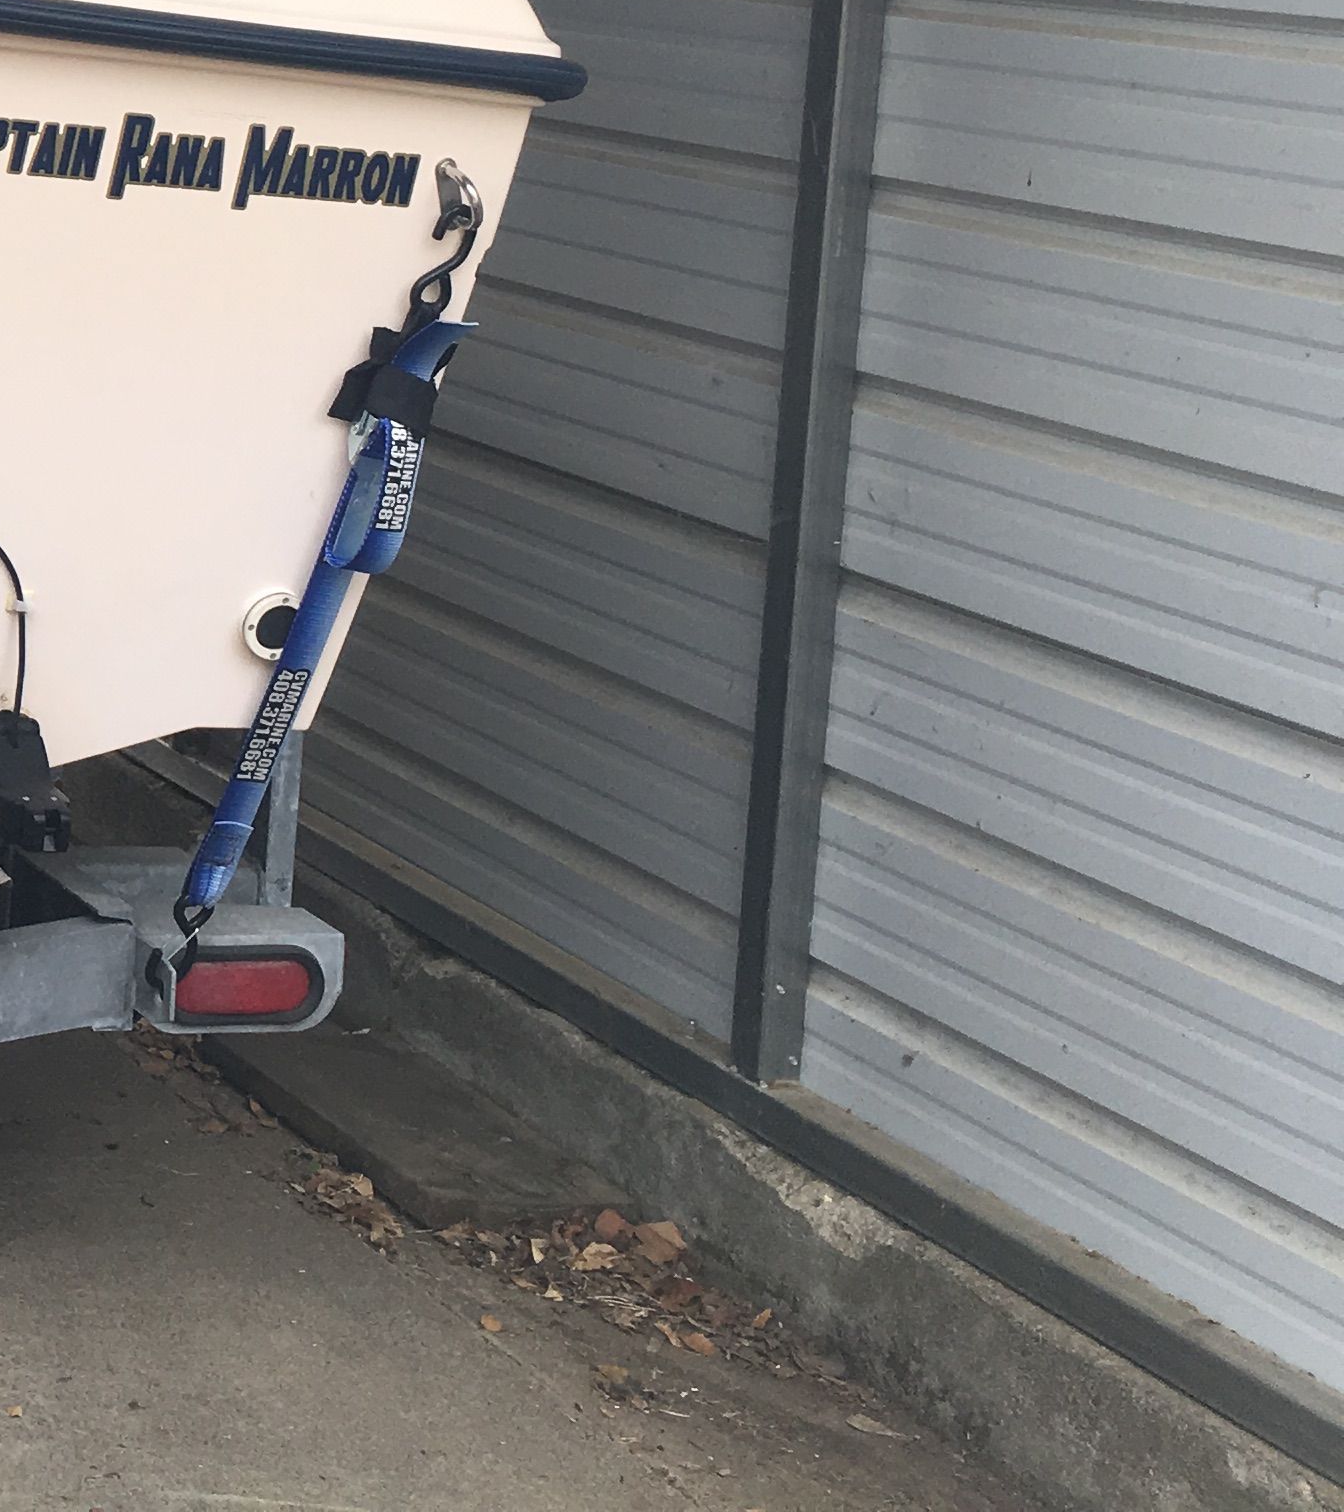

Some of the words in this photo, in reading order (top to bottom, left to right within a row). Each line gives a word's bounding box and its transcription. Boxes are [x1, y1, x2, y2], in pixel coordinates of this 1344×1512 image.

[105, 112, 226, 199] RANA
[231, 123, 421, 210] MARRON
[236, 669, 293, 780] 408.371.6681
[253, 670, 309, 781] CVMARINE.COM
